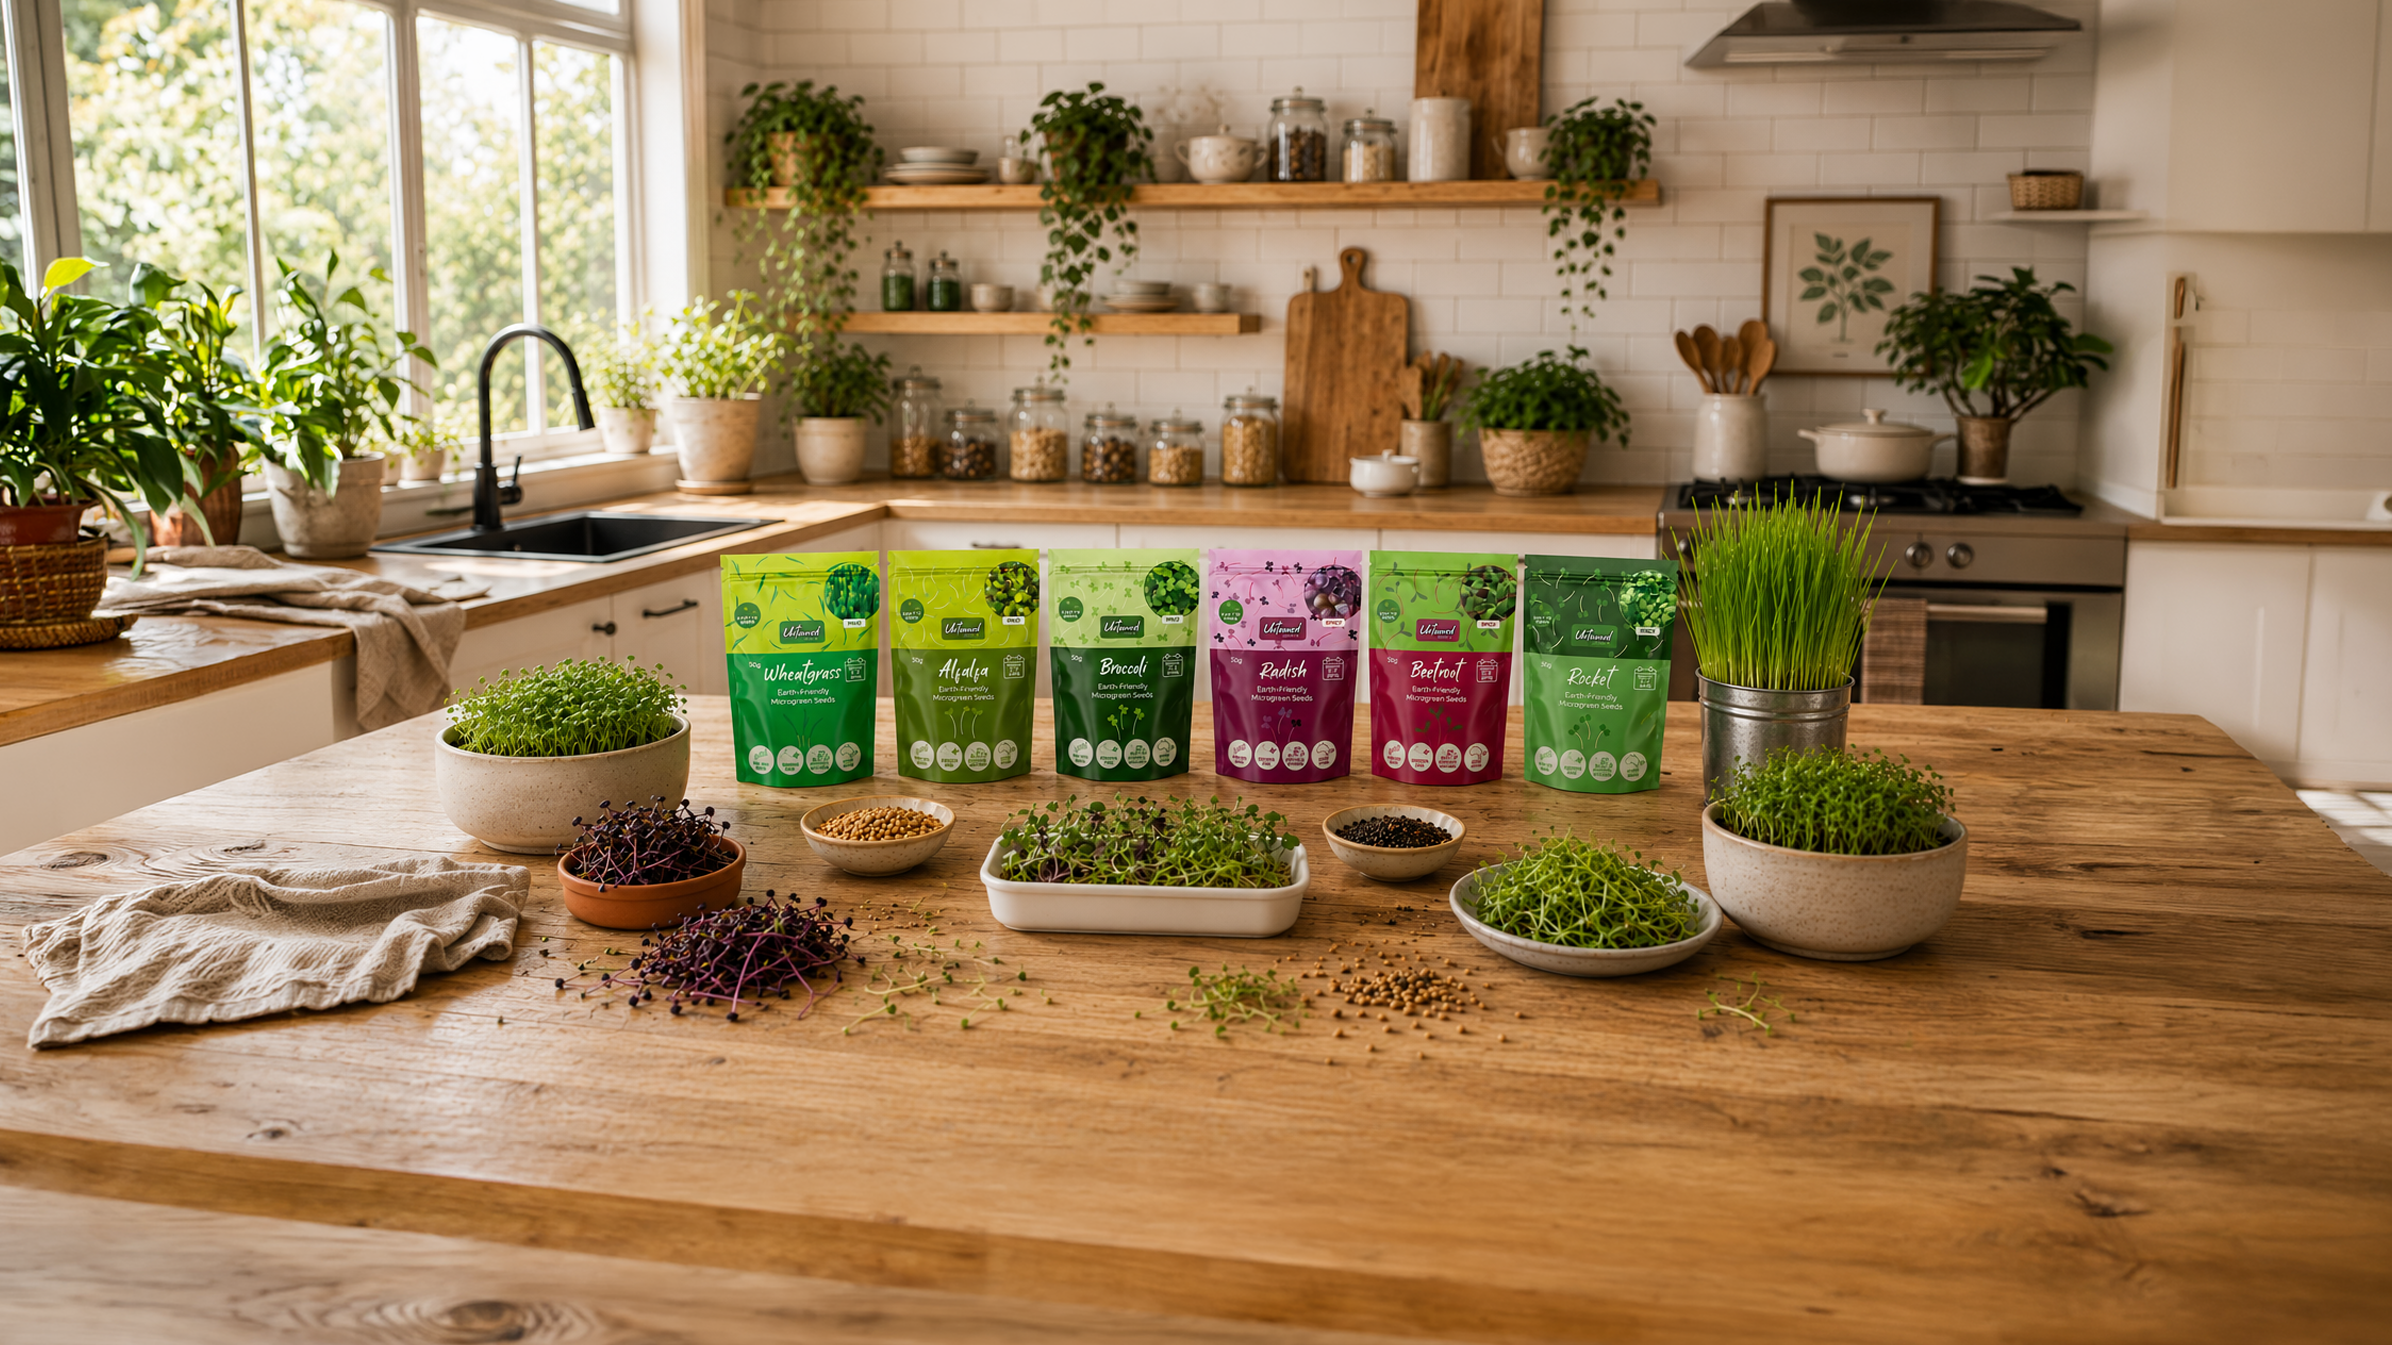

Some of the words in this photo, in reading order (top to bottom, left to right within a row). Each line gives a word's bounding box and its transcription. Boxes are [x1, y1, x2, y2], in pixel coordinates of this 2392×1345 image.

[764, 660, 841, 685] Wheatgrass
[939, 658, 989, 683] Alfalfa
[1100, 656, 1148, 677] Broccoli
[1259, 659, 1307, 679] Radish
[1410, 658, 1467, 683] Beetroot
[1567, 665, 1619, 689] Rocket
[1406, 695, 1444, 703] Microgreen
[1559, 700, 1599, 709] Microgreen
